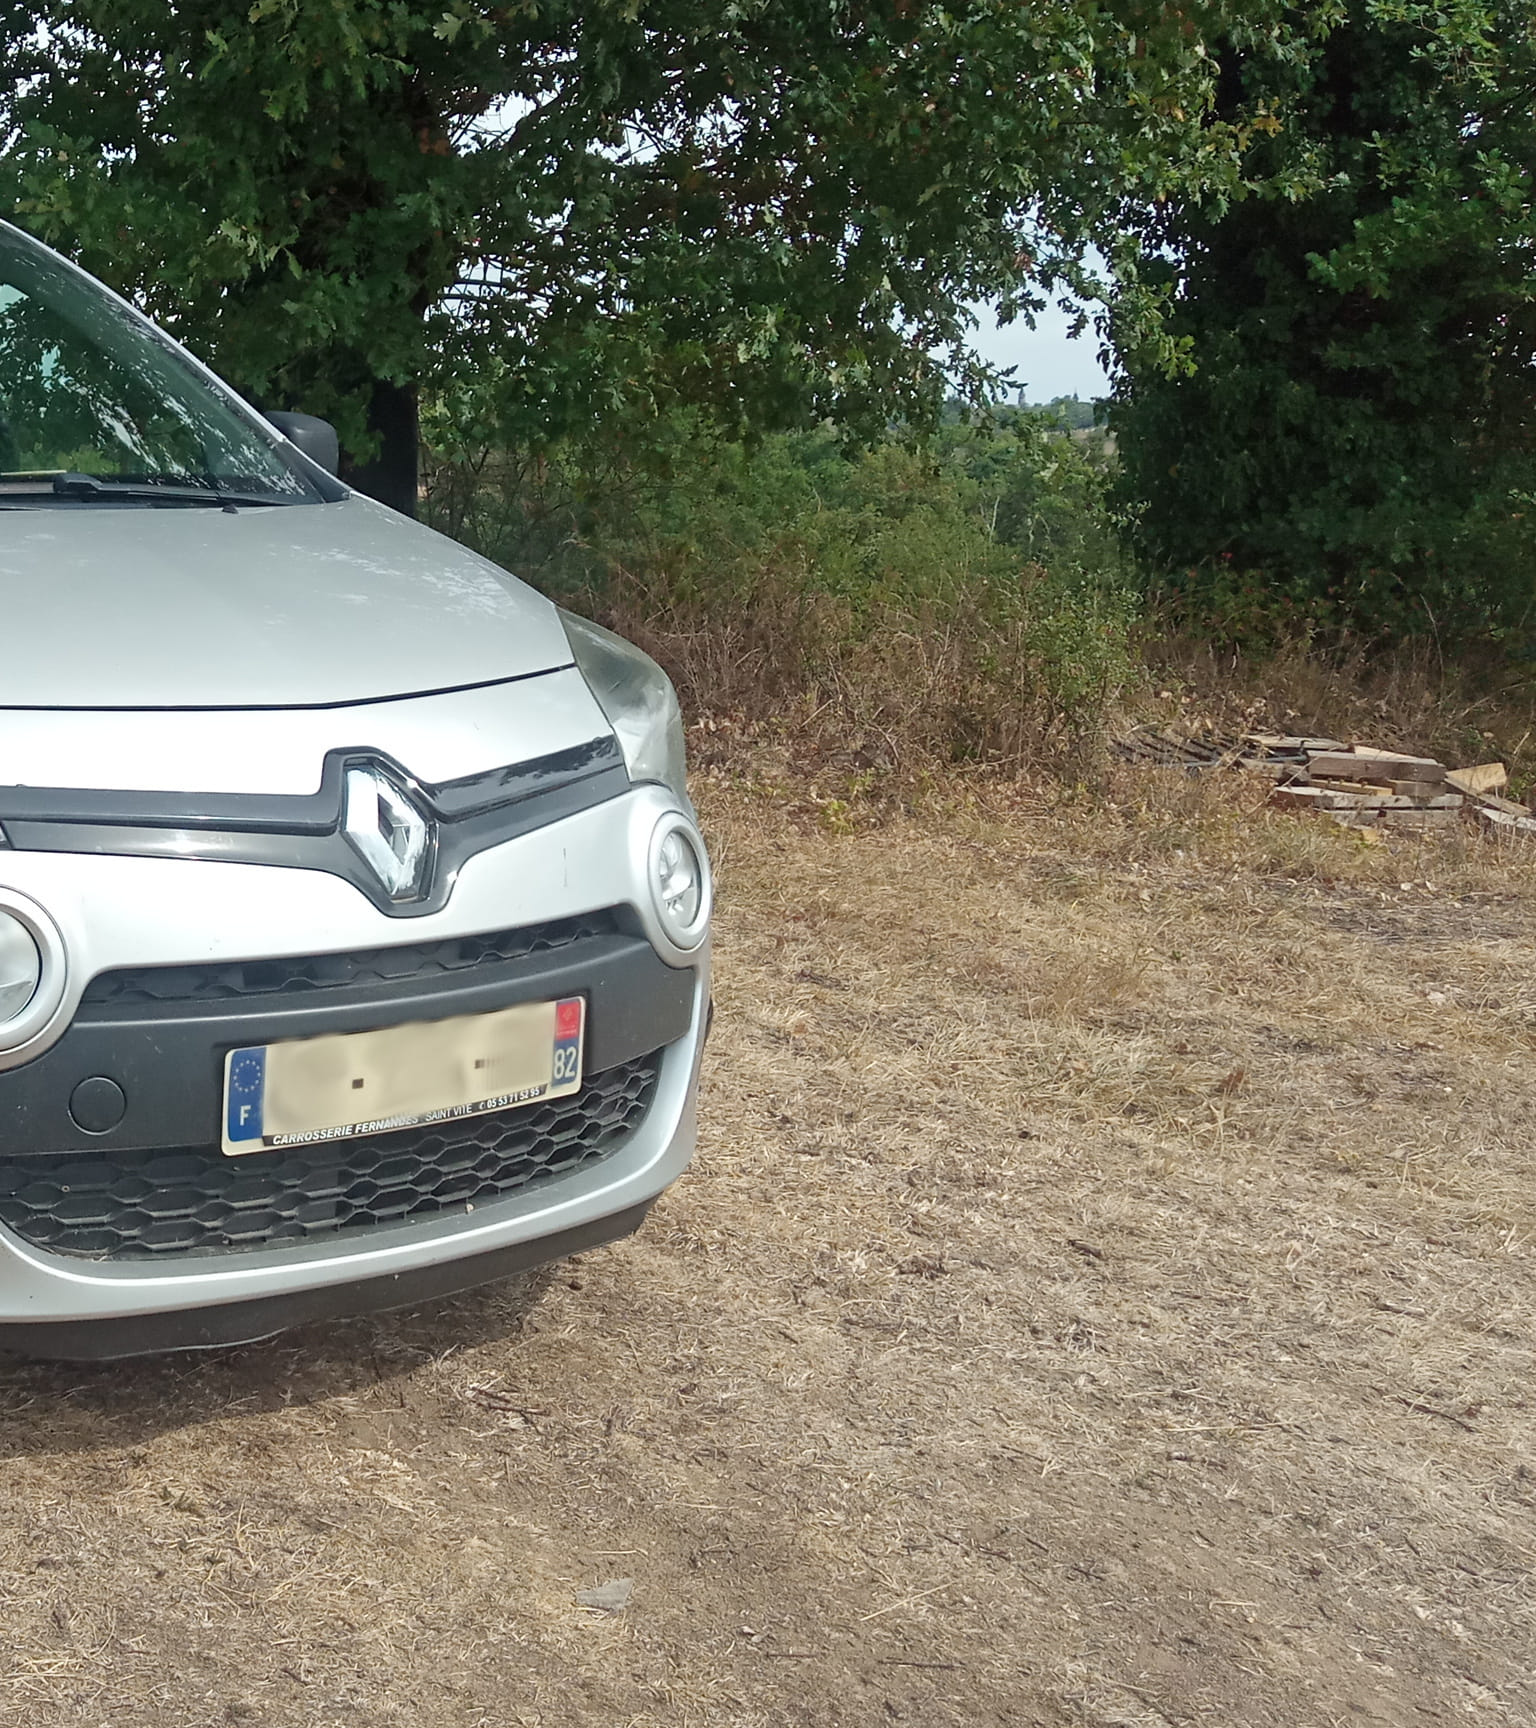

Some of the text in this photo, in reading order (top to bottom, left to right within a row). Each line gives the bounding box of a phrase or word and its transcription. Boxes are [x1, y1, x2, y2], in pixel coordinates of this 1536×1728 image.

[554, 1046, 577, 1080] 82
[239, 1104, 252, 1127] F
[272, 1124, 354, 1146] CARROSSERIE
[425, 1108, 451, 1122] SAINT
[486, 1098, 497, 1109] 05
[498, 1095, 508, 1106] 53
[509, 1093, 518, 1104] 71
[519, 1090, 529, 1101] 52
